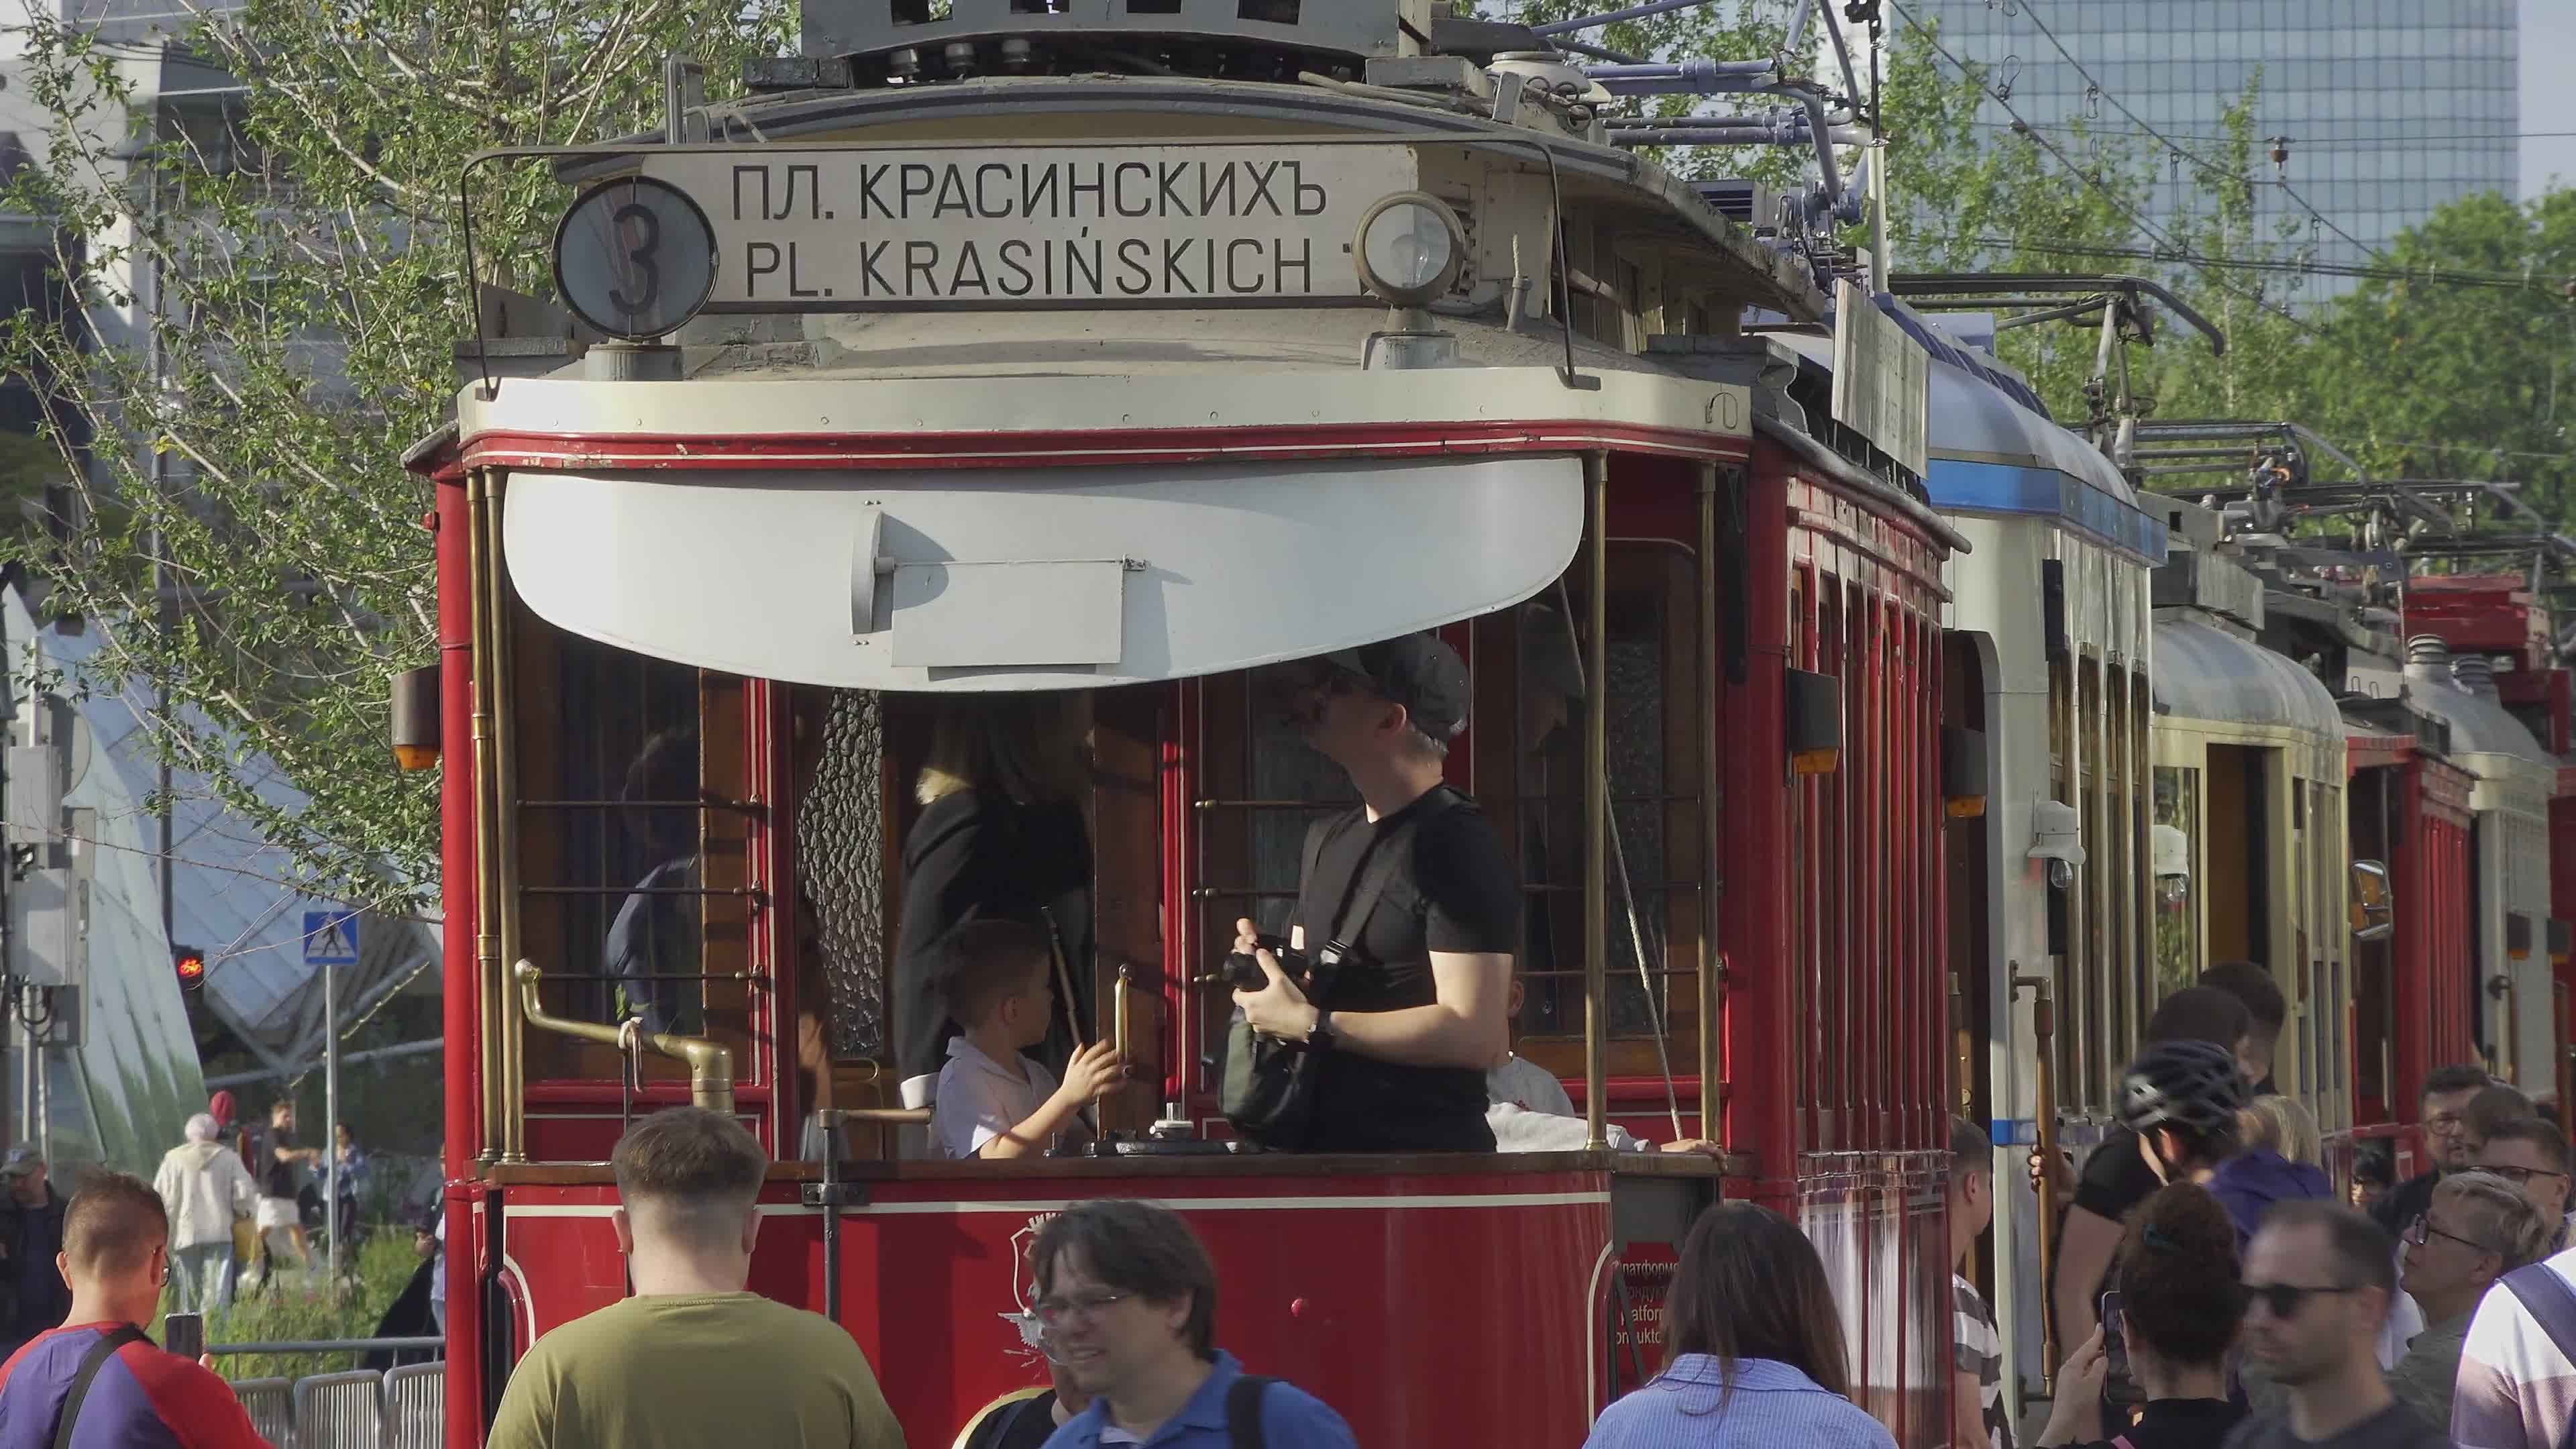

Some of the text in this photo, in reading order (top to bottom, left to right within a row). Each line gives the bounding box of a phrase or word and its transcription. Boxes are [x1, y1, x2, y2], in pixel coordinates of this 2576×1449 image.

[732, 160, 1326, 221] ПЛ. КРАСИНСКИХЪ
[608, 204, 659, 316] 3
[746, 226, 1311, 299] PL. KRASIŃSKICH
